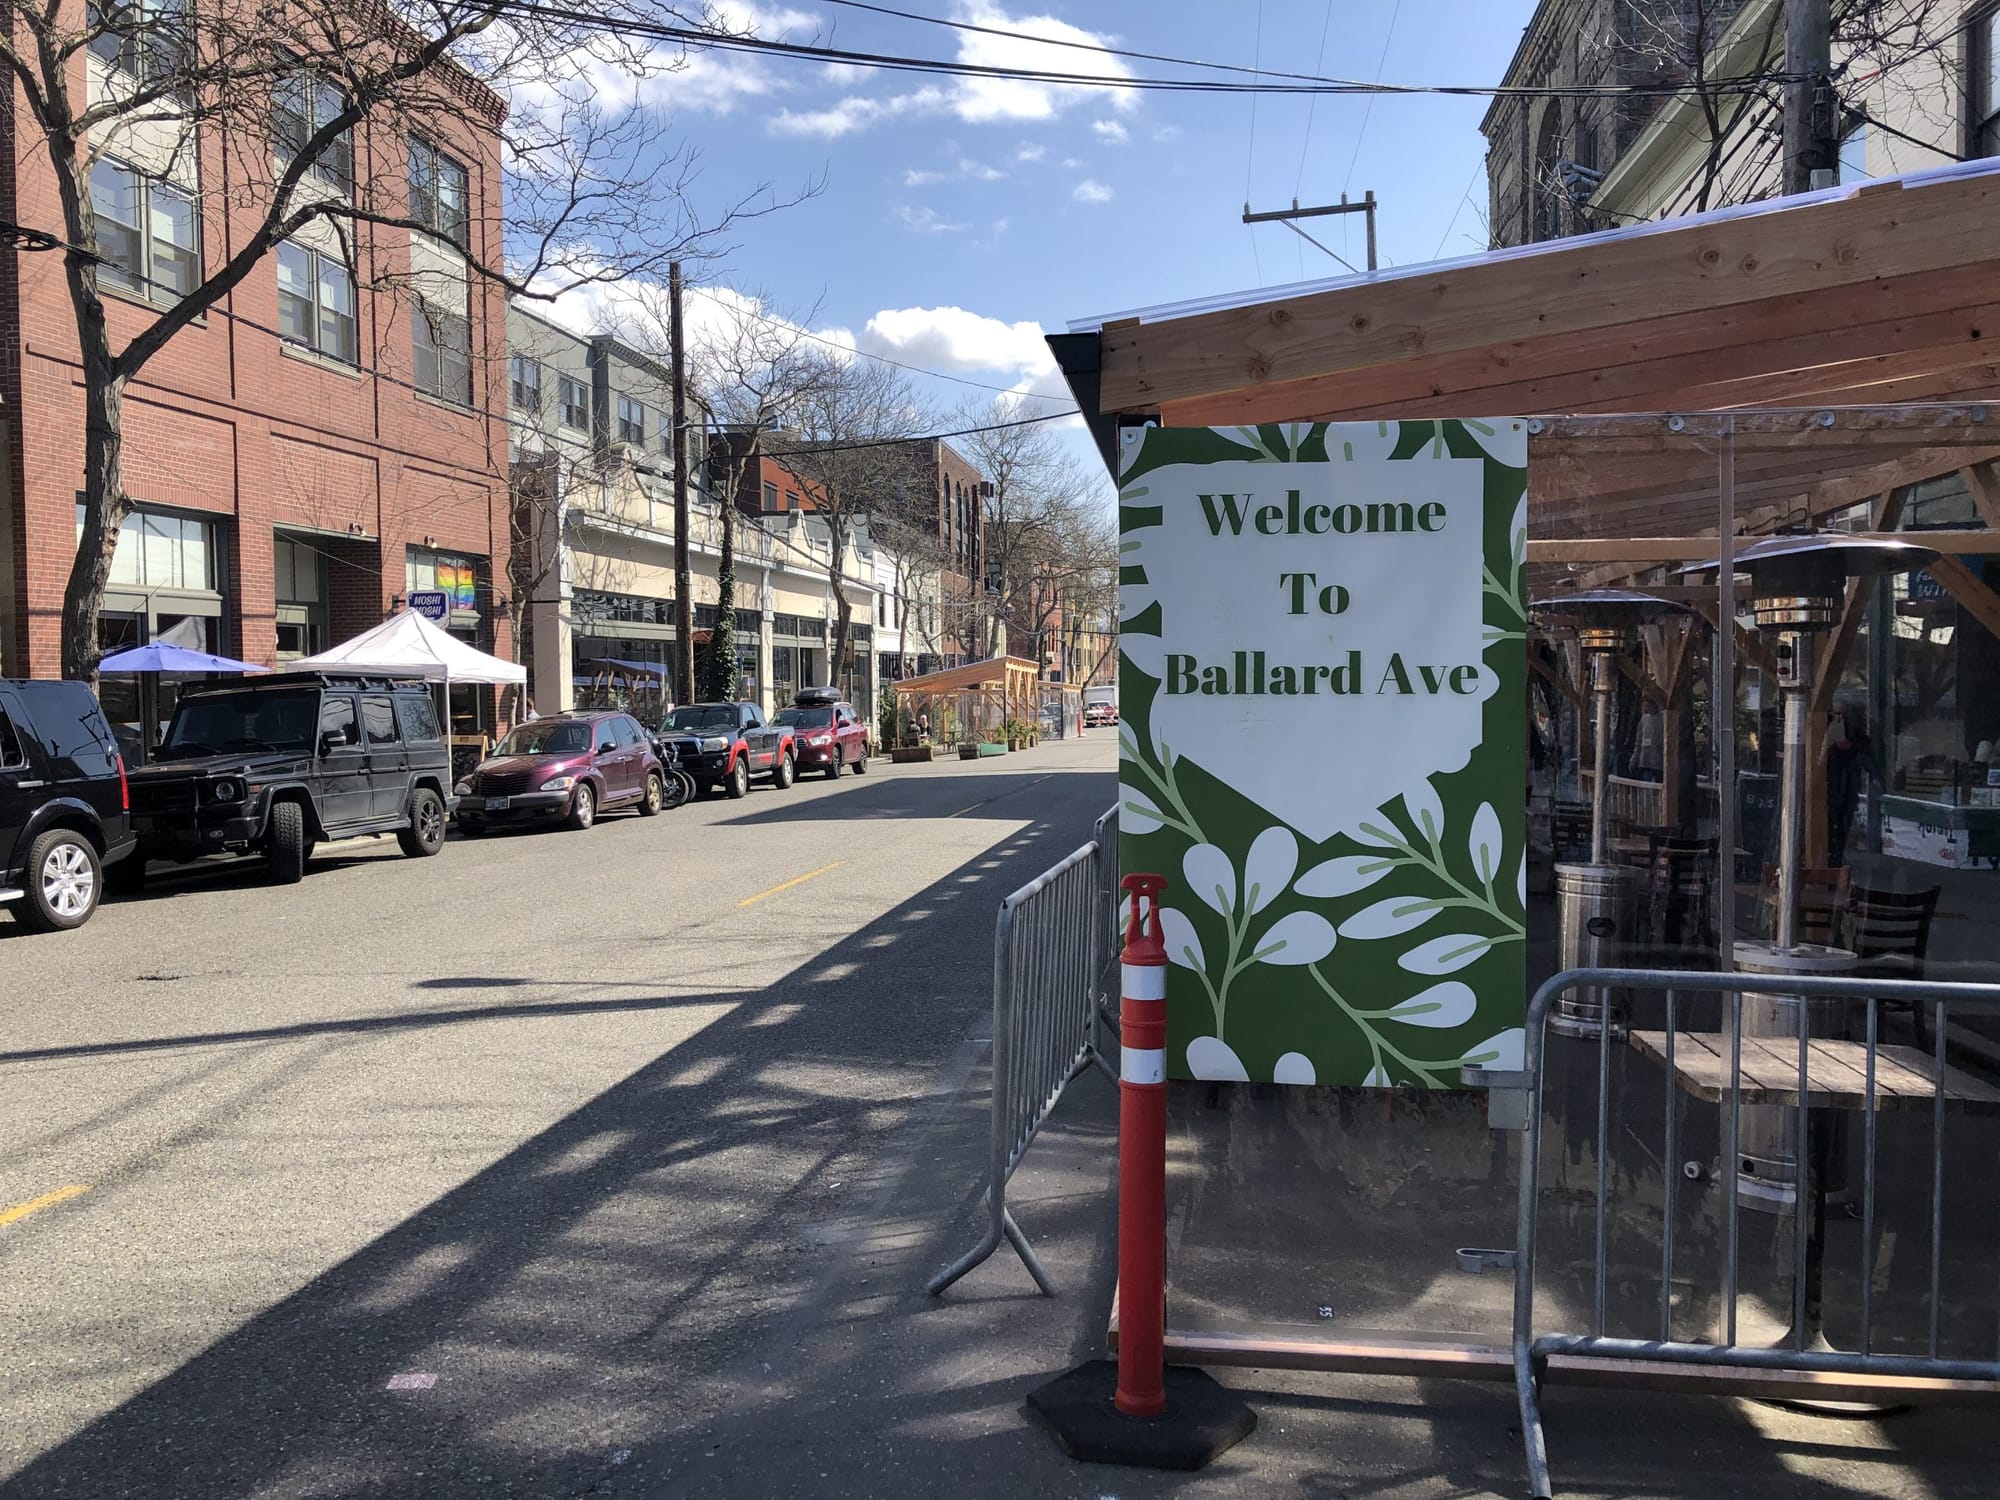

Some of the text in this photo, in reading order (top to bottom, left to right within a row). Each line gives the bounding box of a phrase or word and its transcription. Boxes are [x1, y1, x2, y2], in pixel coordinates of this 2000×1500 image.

[1196, 489, 1447, 536] Welcome
[413, 594, 441, 605] MOSHI
[1280, 573, 1350, 615] To
[1163, 650, 1479, 696] Ballard Ave
